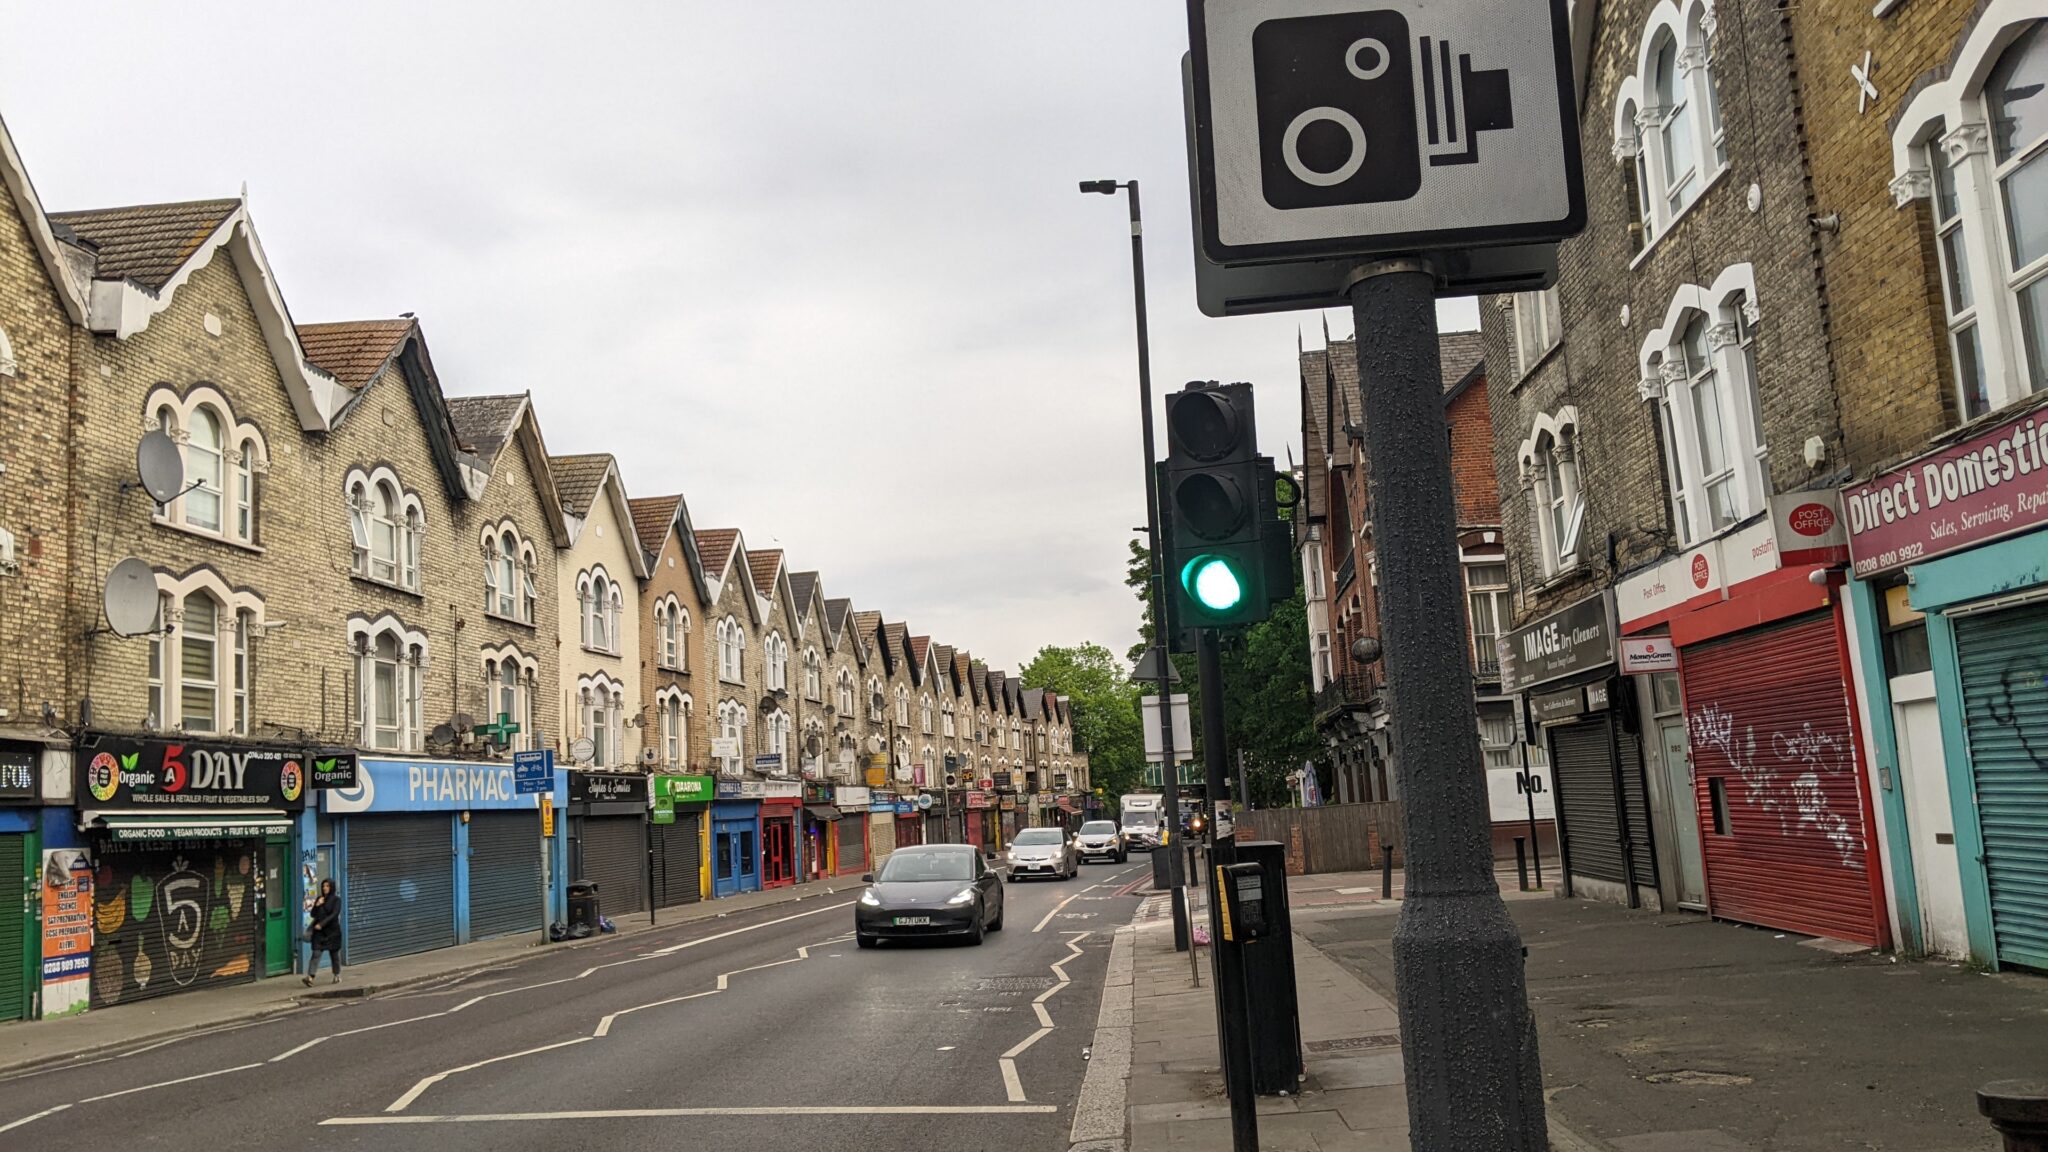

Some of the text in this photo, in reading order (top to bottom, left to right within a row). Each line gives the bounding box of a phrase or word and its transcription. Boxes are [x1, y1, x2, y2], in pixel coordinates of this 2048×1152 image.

[1848, 470, 1920, 535] Direct
[1799, 507, 1824, 520] POST
[1930, 518, 1957, 540] Sales,
[1961, 502, 2013, 531] Servicing,
[1794, 517, 1830, 529] OFFICE
[1752, 538, 1774, 560] postoffi
[1694, 560, 1705, 570] POST
[1856, 542, 1924, 573] 0208 800 9922
[1694, 570, 1708, 582] OFFICE
[1643, 583, 1666, 599] Post Office
[1523, 622, 1560, 662] IMAGE
[1561, 634, 1571, 652] Dry
[1572, 625, 1600, 645] Cleaners
[1630, 652, 1672, 660] MoneyGram
[1588, 688, 1607, 704] IMAGE
[160, 745, 249, 792] 5 A DAY
[314, 770, 352, 782] Organic
[119, 771, 155, 787] Organic
[588, 778, 607, 799] Styles
[613, 779, 631, 793] Smiles
[132, 794, 153, 803] WHOLE
[154, 794, 169, 803] SALE
[119, 829, 148, 838] ORGANIC
[148, 829, 165, 838] FOOD
[173, 829, 193, 837] VEGAN
[194, 828, 222, 836] PRODUCTS
[229, 827, 243, 835] FRUIT
[249, 827, 259, 835] VEG
[266, 826, 287, 834] GROCERY
[58, 891, 77, 899] ENGLISH
[164, 879, 201, 948] 5 A
[170, 949, 201, 970] DAY
